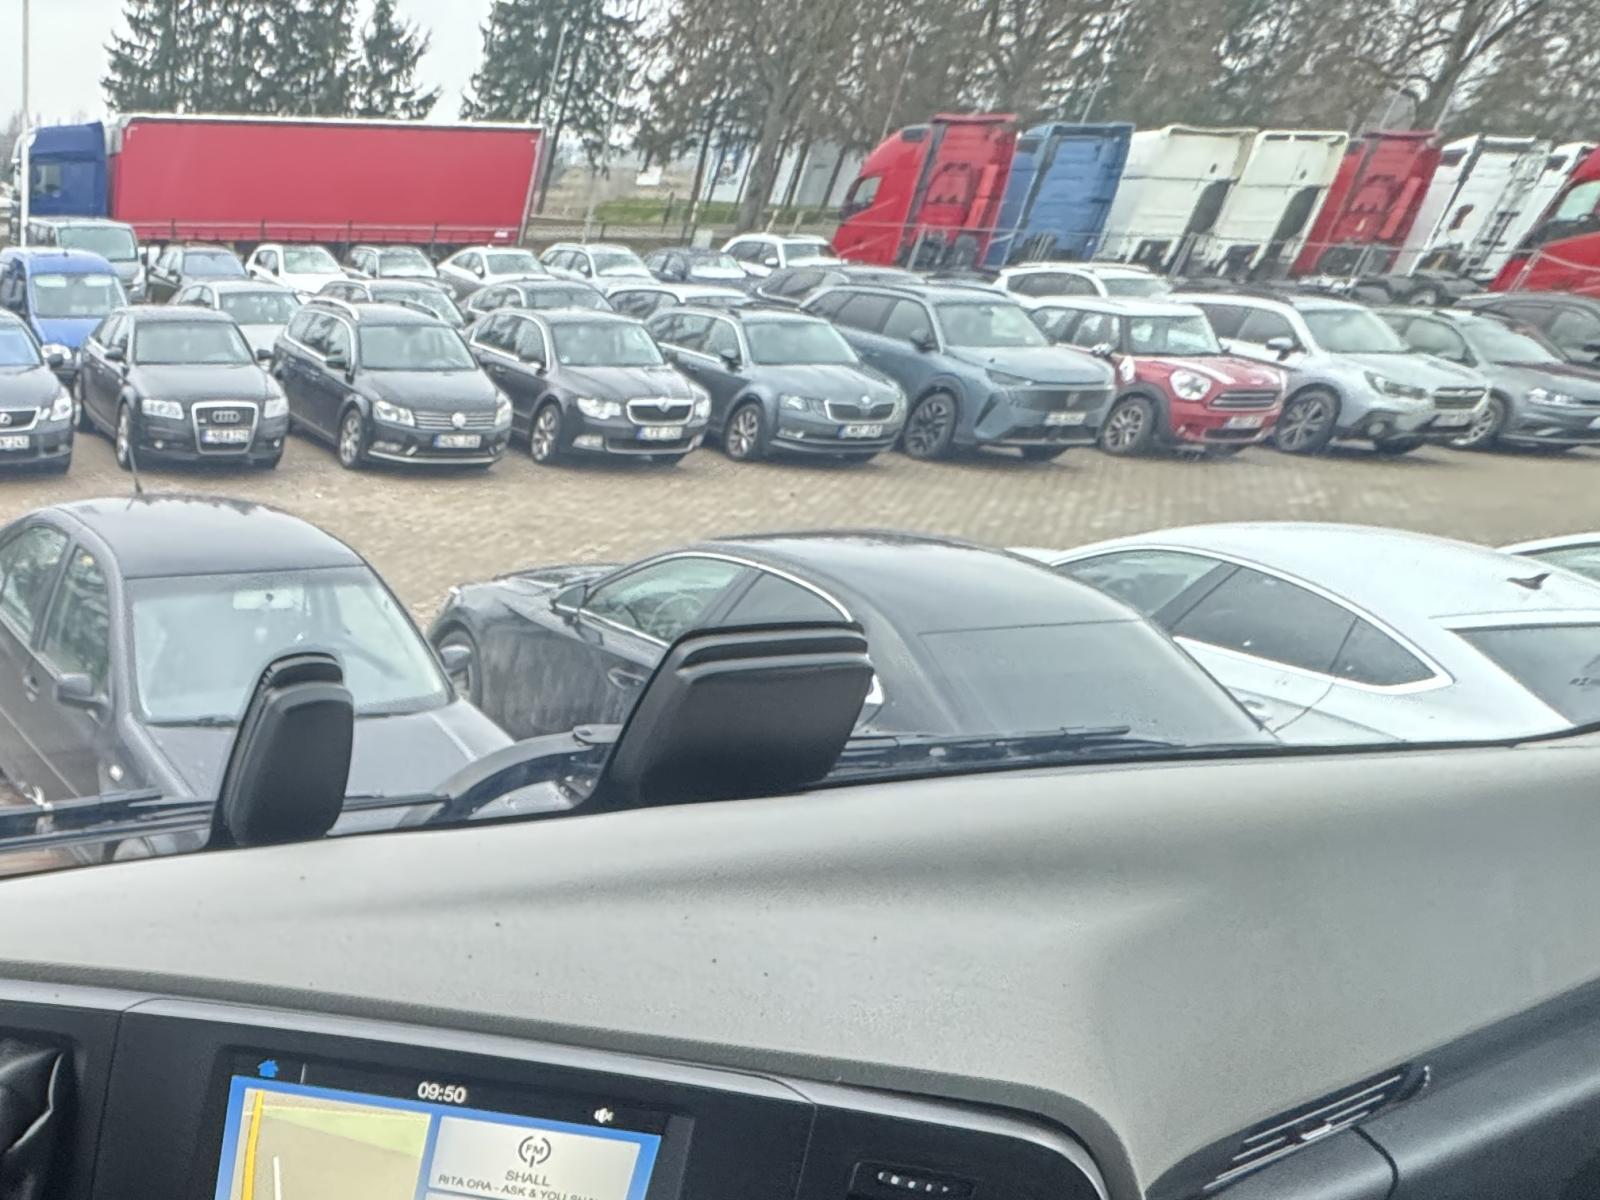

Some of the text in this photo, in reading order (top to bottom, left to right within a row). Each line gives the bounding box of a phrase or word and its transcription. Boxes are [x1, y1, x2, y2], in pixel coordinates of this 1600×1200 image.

[417, 1080, 467, 1105] 09:50
[525, 1143, 545, 1157] FM
[438, 1173, 464, 1187] RITA
[466, 1178, 492, 1192] ORA
[500, 1184, 526, 1198] ASK
[529, 1186, 537, 1198] &
[505, 1169, 550, 1187] SHALL
